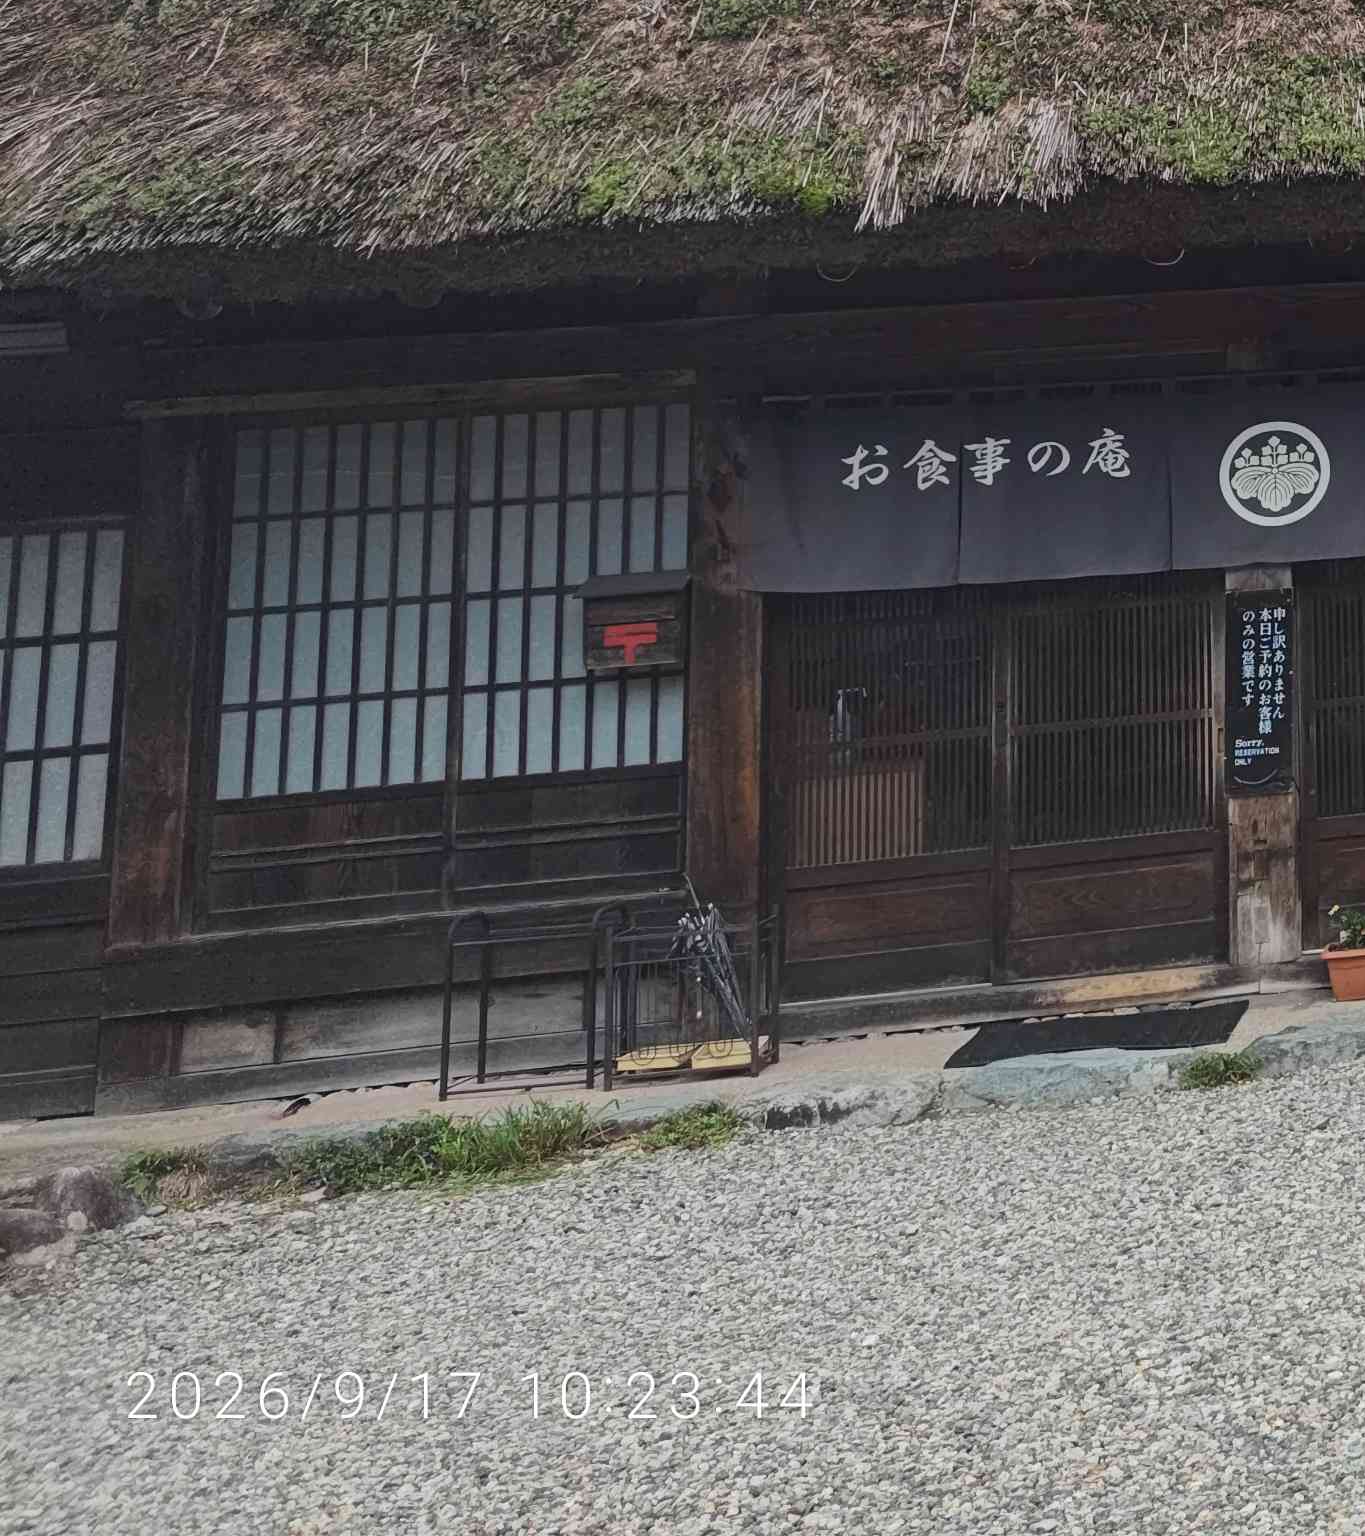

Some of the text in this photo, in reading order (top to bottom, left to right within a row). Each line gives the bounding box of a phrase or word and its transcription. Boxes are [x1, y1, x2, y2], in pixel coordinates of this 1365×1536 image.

[840, 428, 1130, 490] お食事の庵
[1242, 610, 1255, 706] のみの営業です
[1259, 607, 1272, 734] 本日ご予約のお客様
[1272, 607, 1286, 719] 申し訳ありません
[1234, 747, 1280, 757] RESERVATION
[1234, 758, 1252, 766] ONLY
